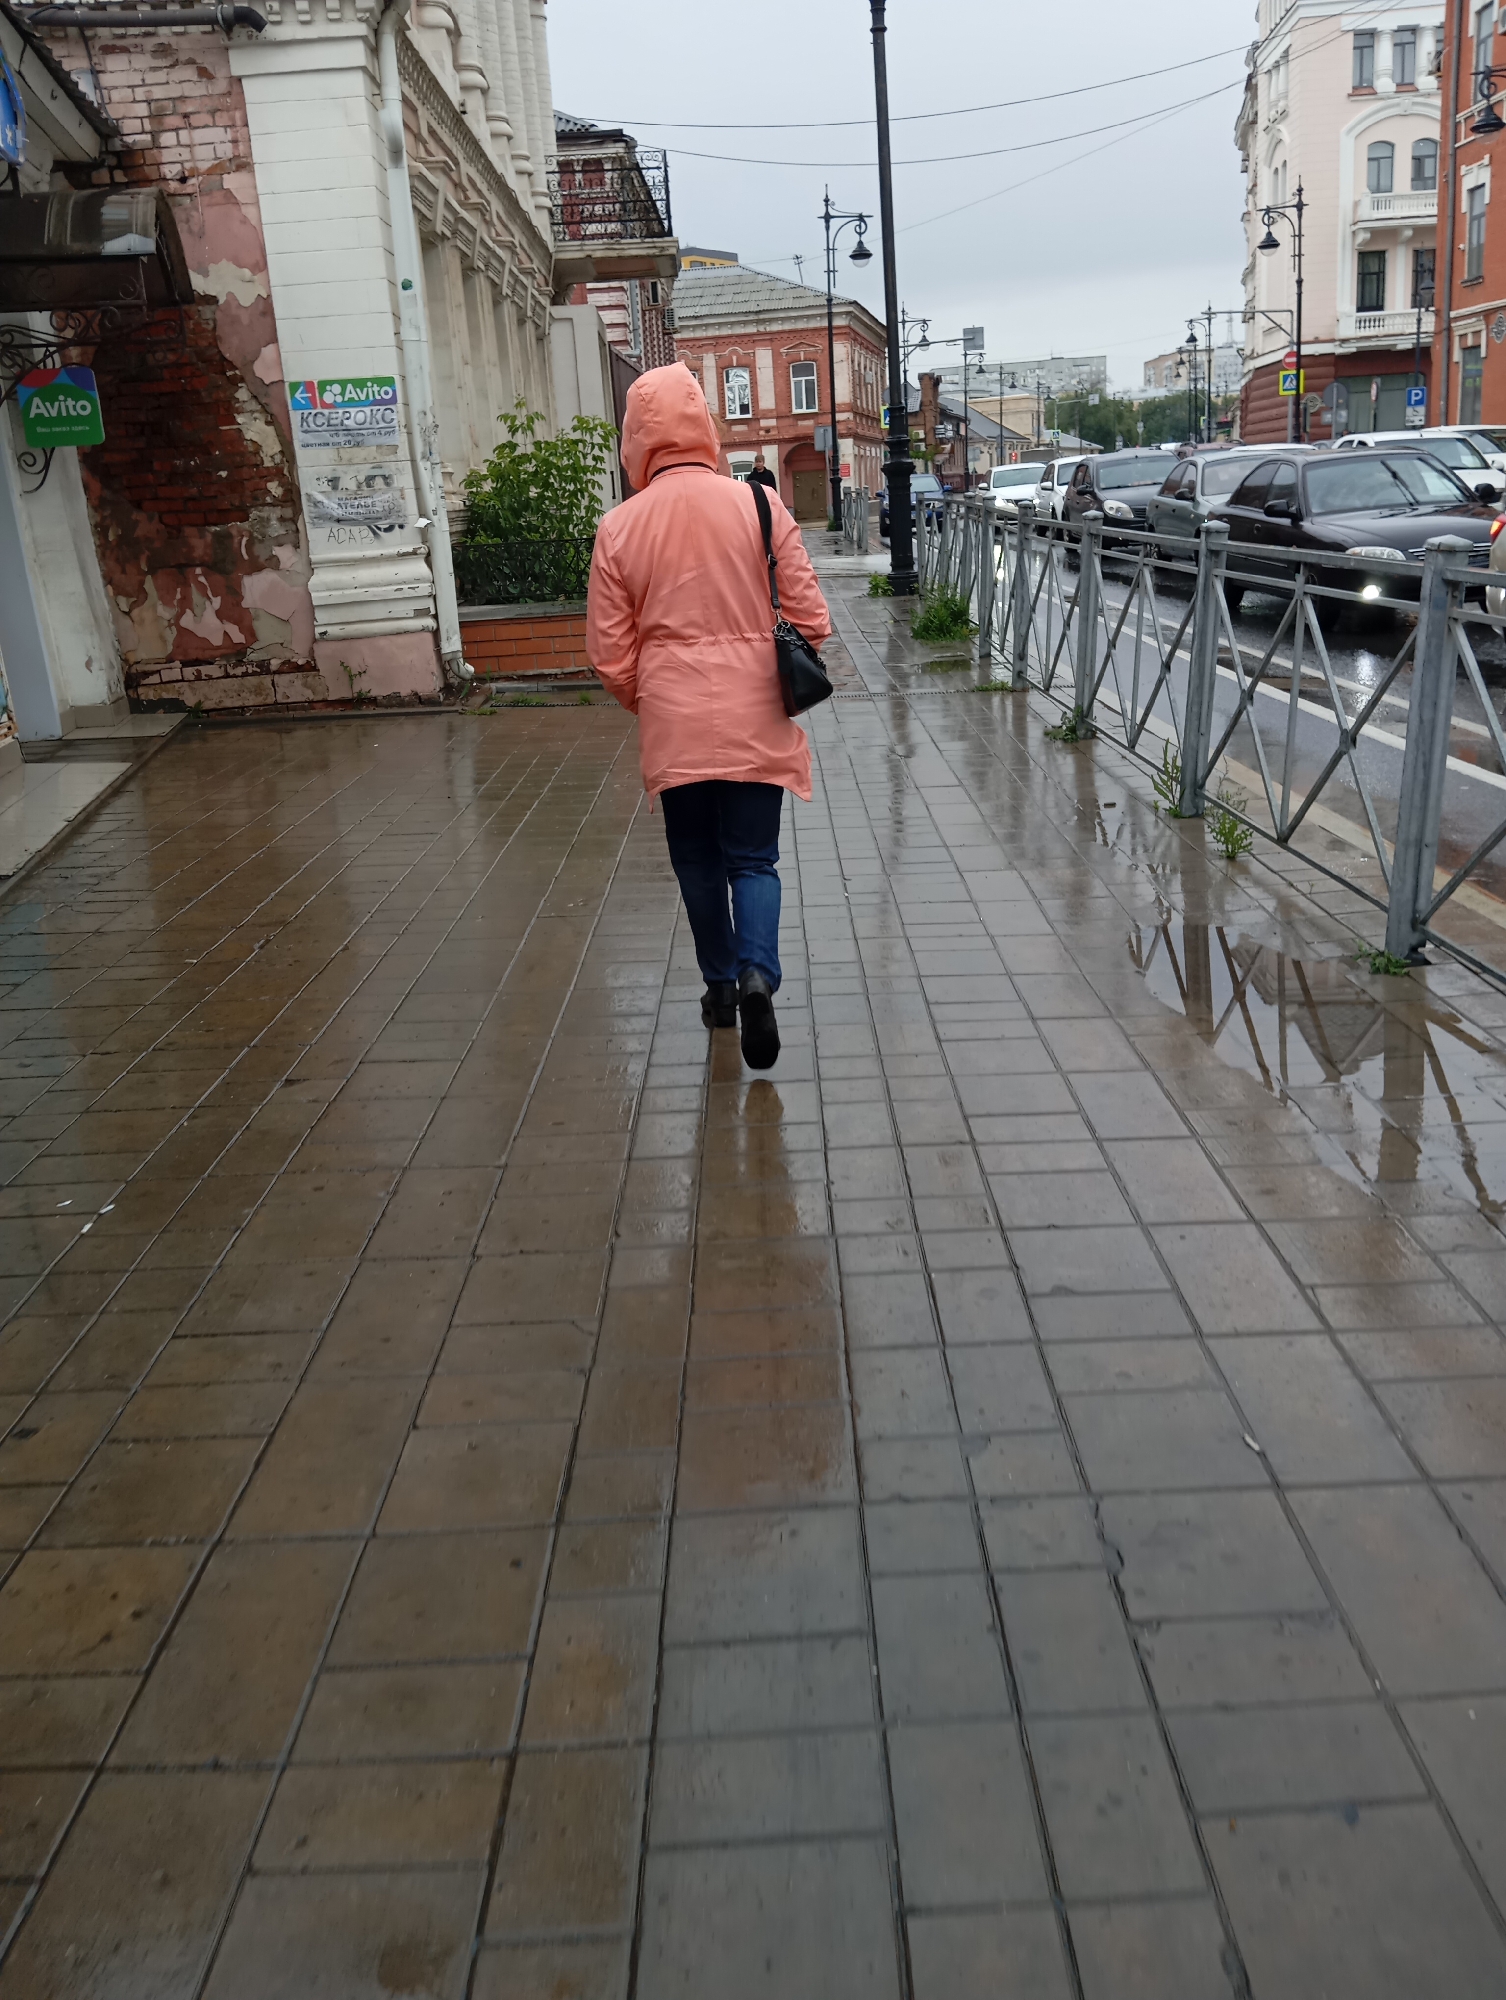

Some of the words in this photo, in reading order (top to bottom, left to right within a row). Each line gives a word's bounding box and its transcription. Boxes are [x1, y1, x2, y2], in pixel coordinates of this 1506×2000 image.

[343, 382, 393, 402] Avito
[1411, 389, 1422, 405] P
[29, 395, 92, 418] Avito
[300, 407, 395, 428] КСЕРОКС
